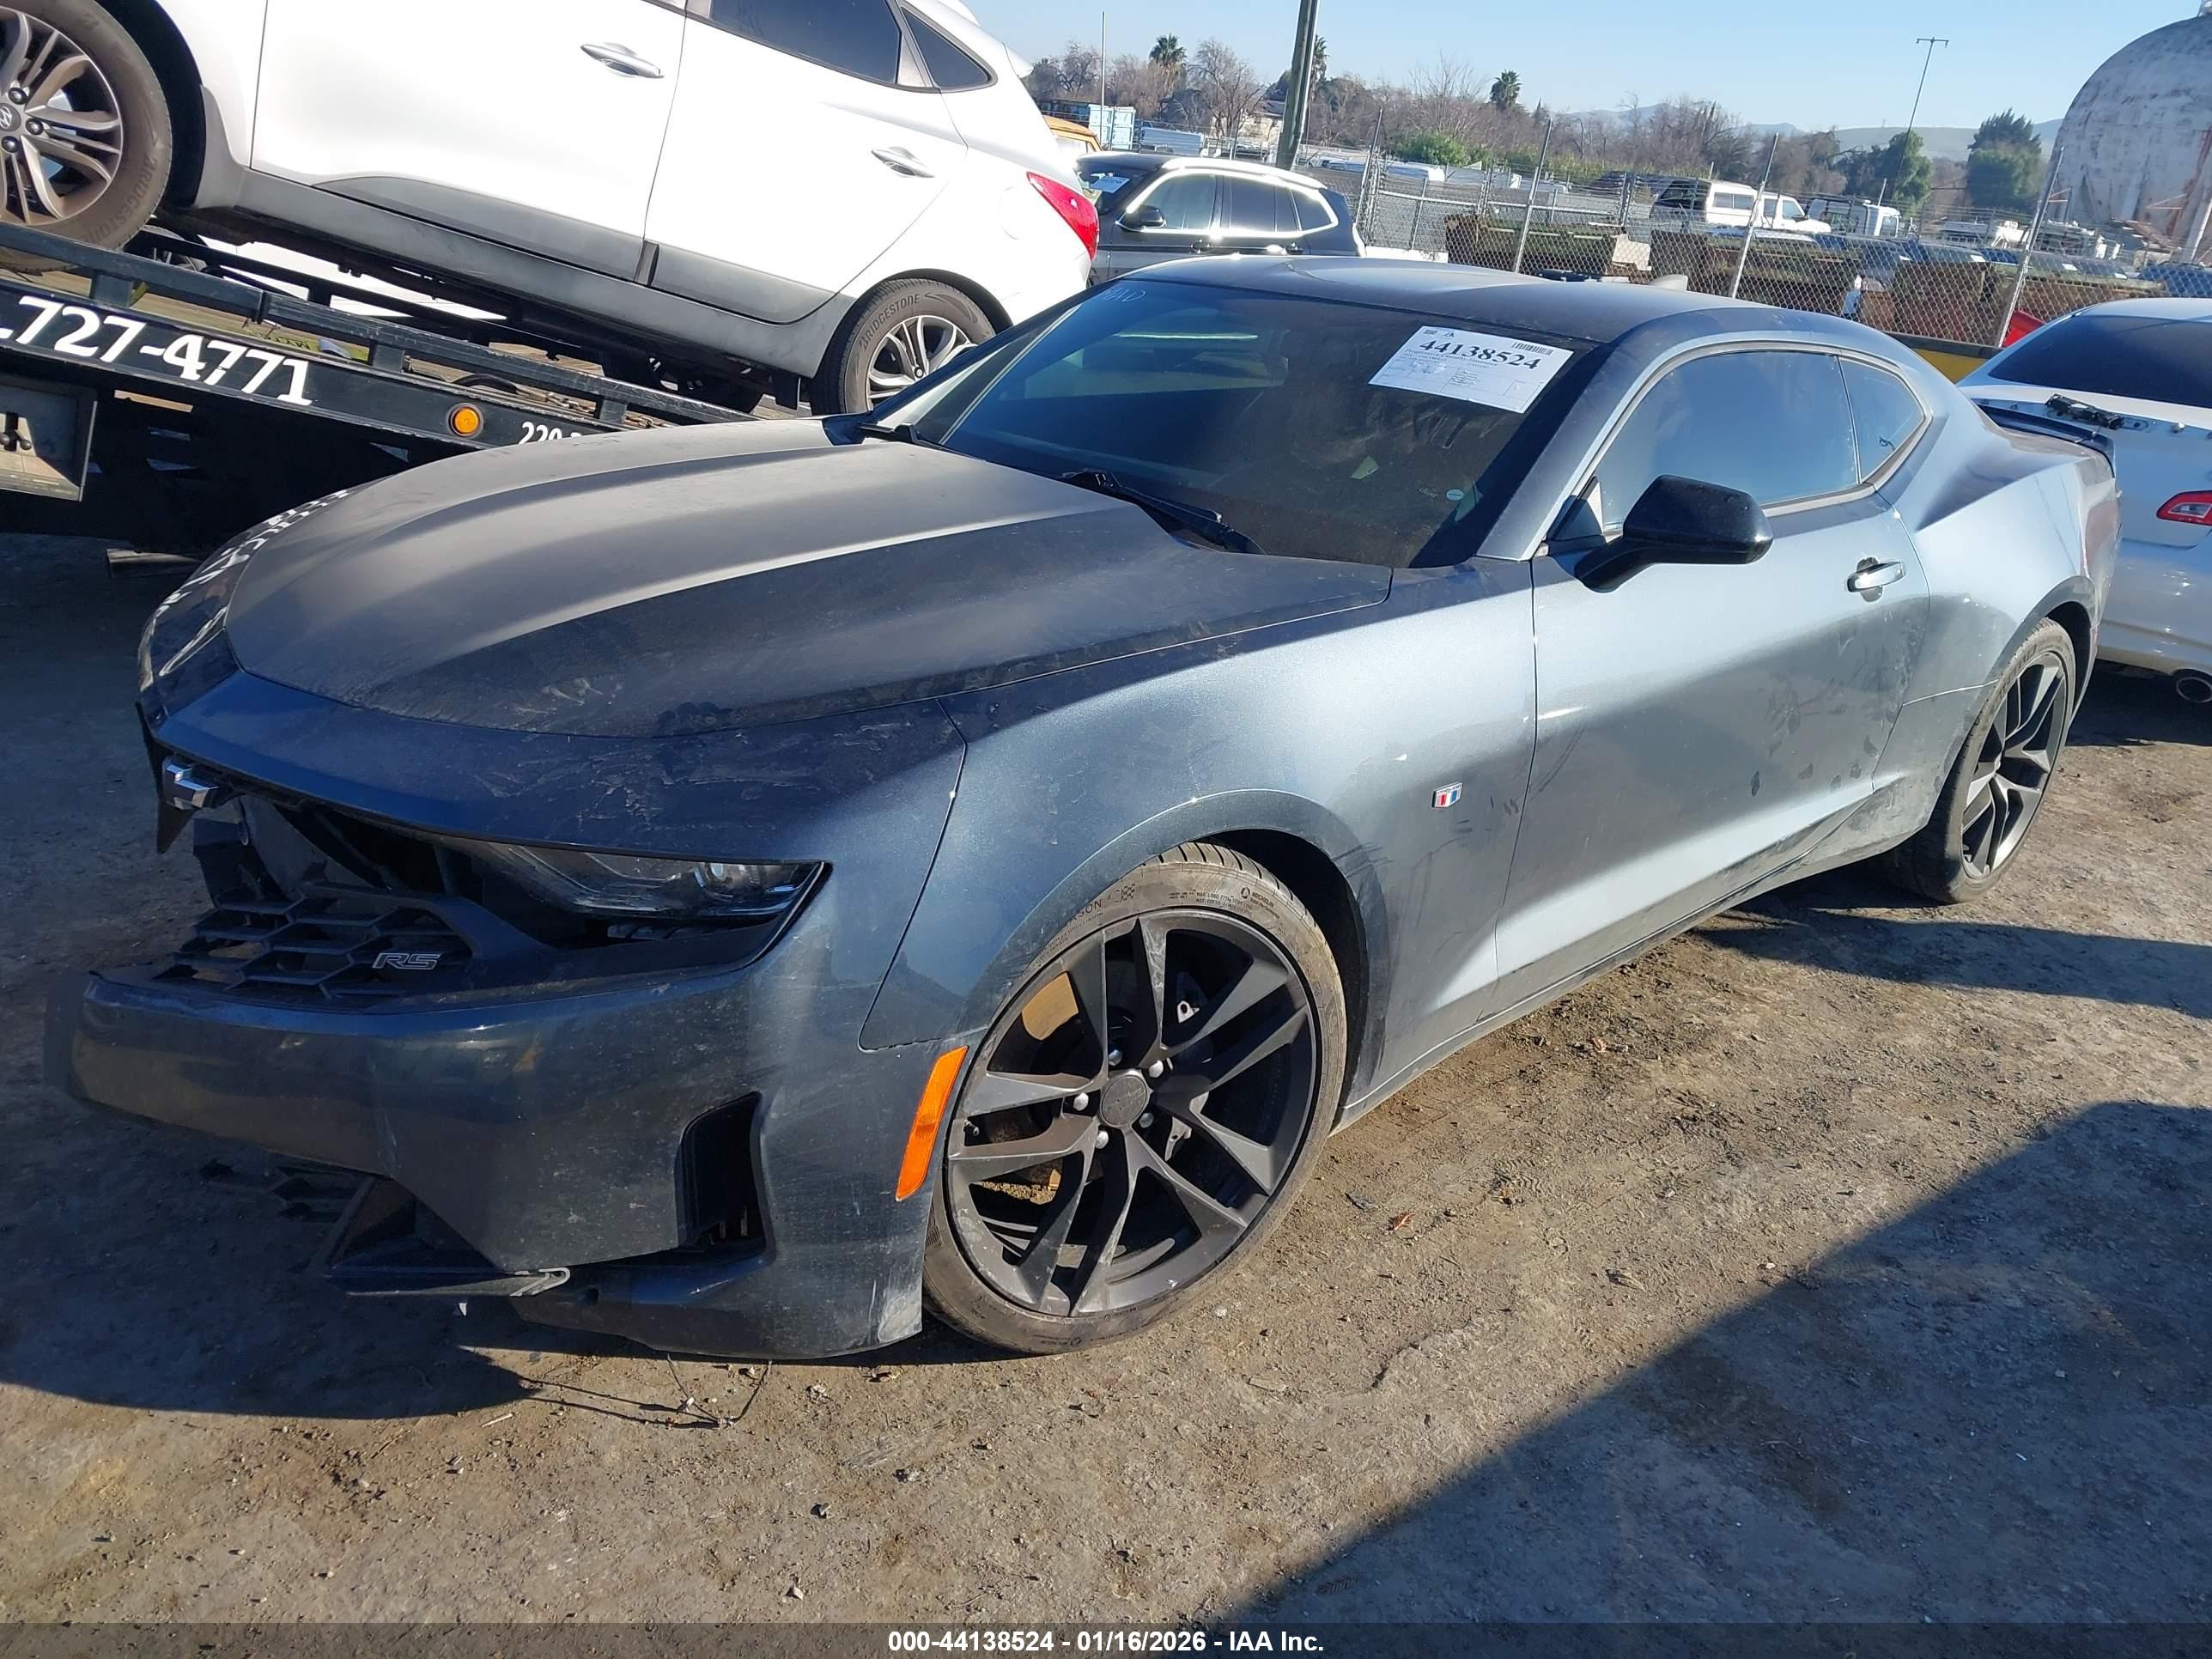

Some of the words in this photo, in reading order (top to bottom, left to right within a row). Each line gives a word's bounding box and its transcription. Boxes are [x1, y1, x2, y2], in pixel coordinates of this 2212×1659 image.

[860, 294, 921, 350] BRIDGESTONE
[1419, 340, 1542, 370] 44138524
[372, 952, 441, 970] RS
